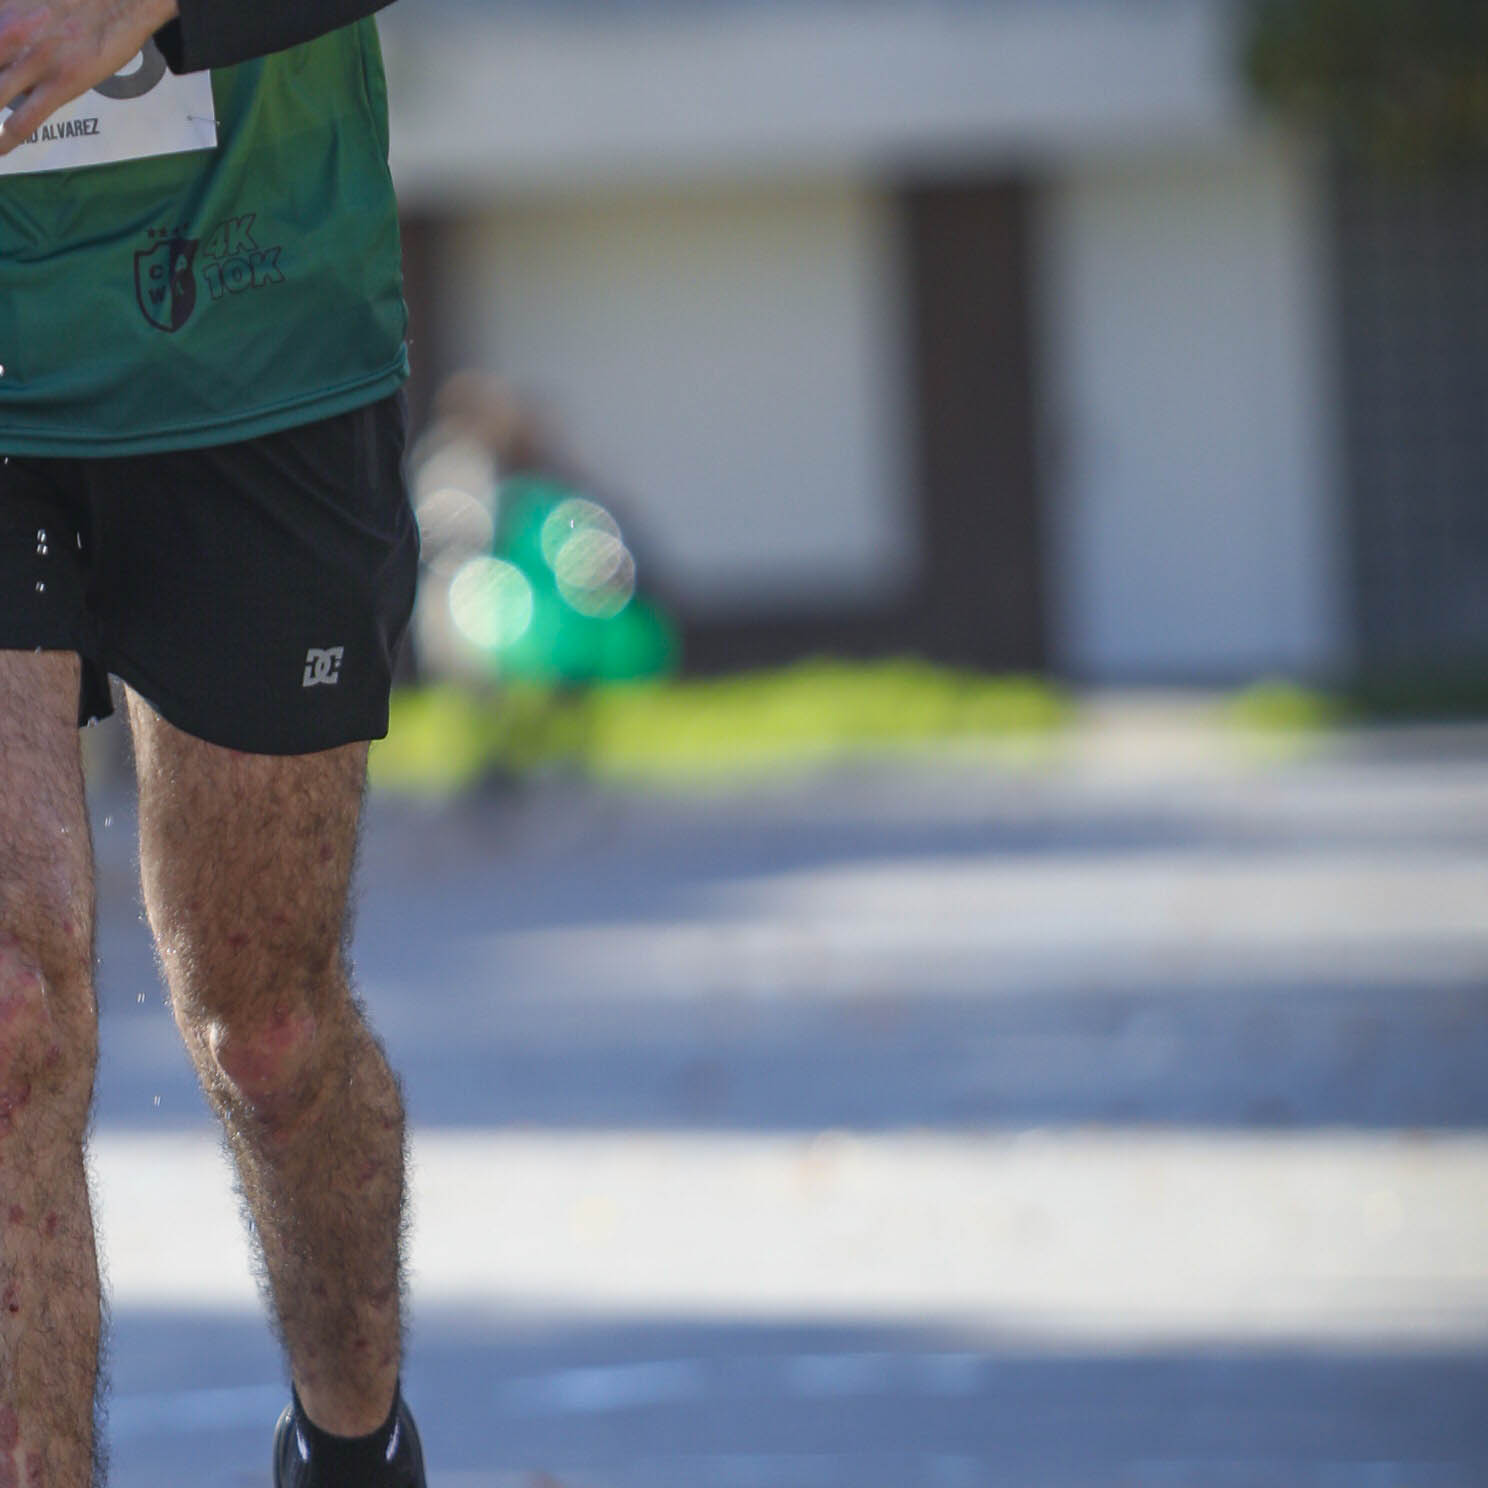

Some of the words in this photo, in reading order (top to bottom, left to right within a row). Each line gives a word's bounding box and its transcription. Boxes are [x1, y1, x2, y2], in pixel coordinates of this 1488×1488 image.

[42, 118, 100, 141] ALVAREZ
[203, 213, 259, 259] 4K
[202, 245, 286, 301] 10K
